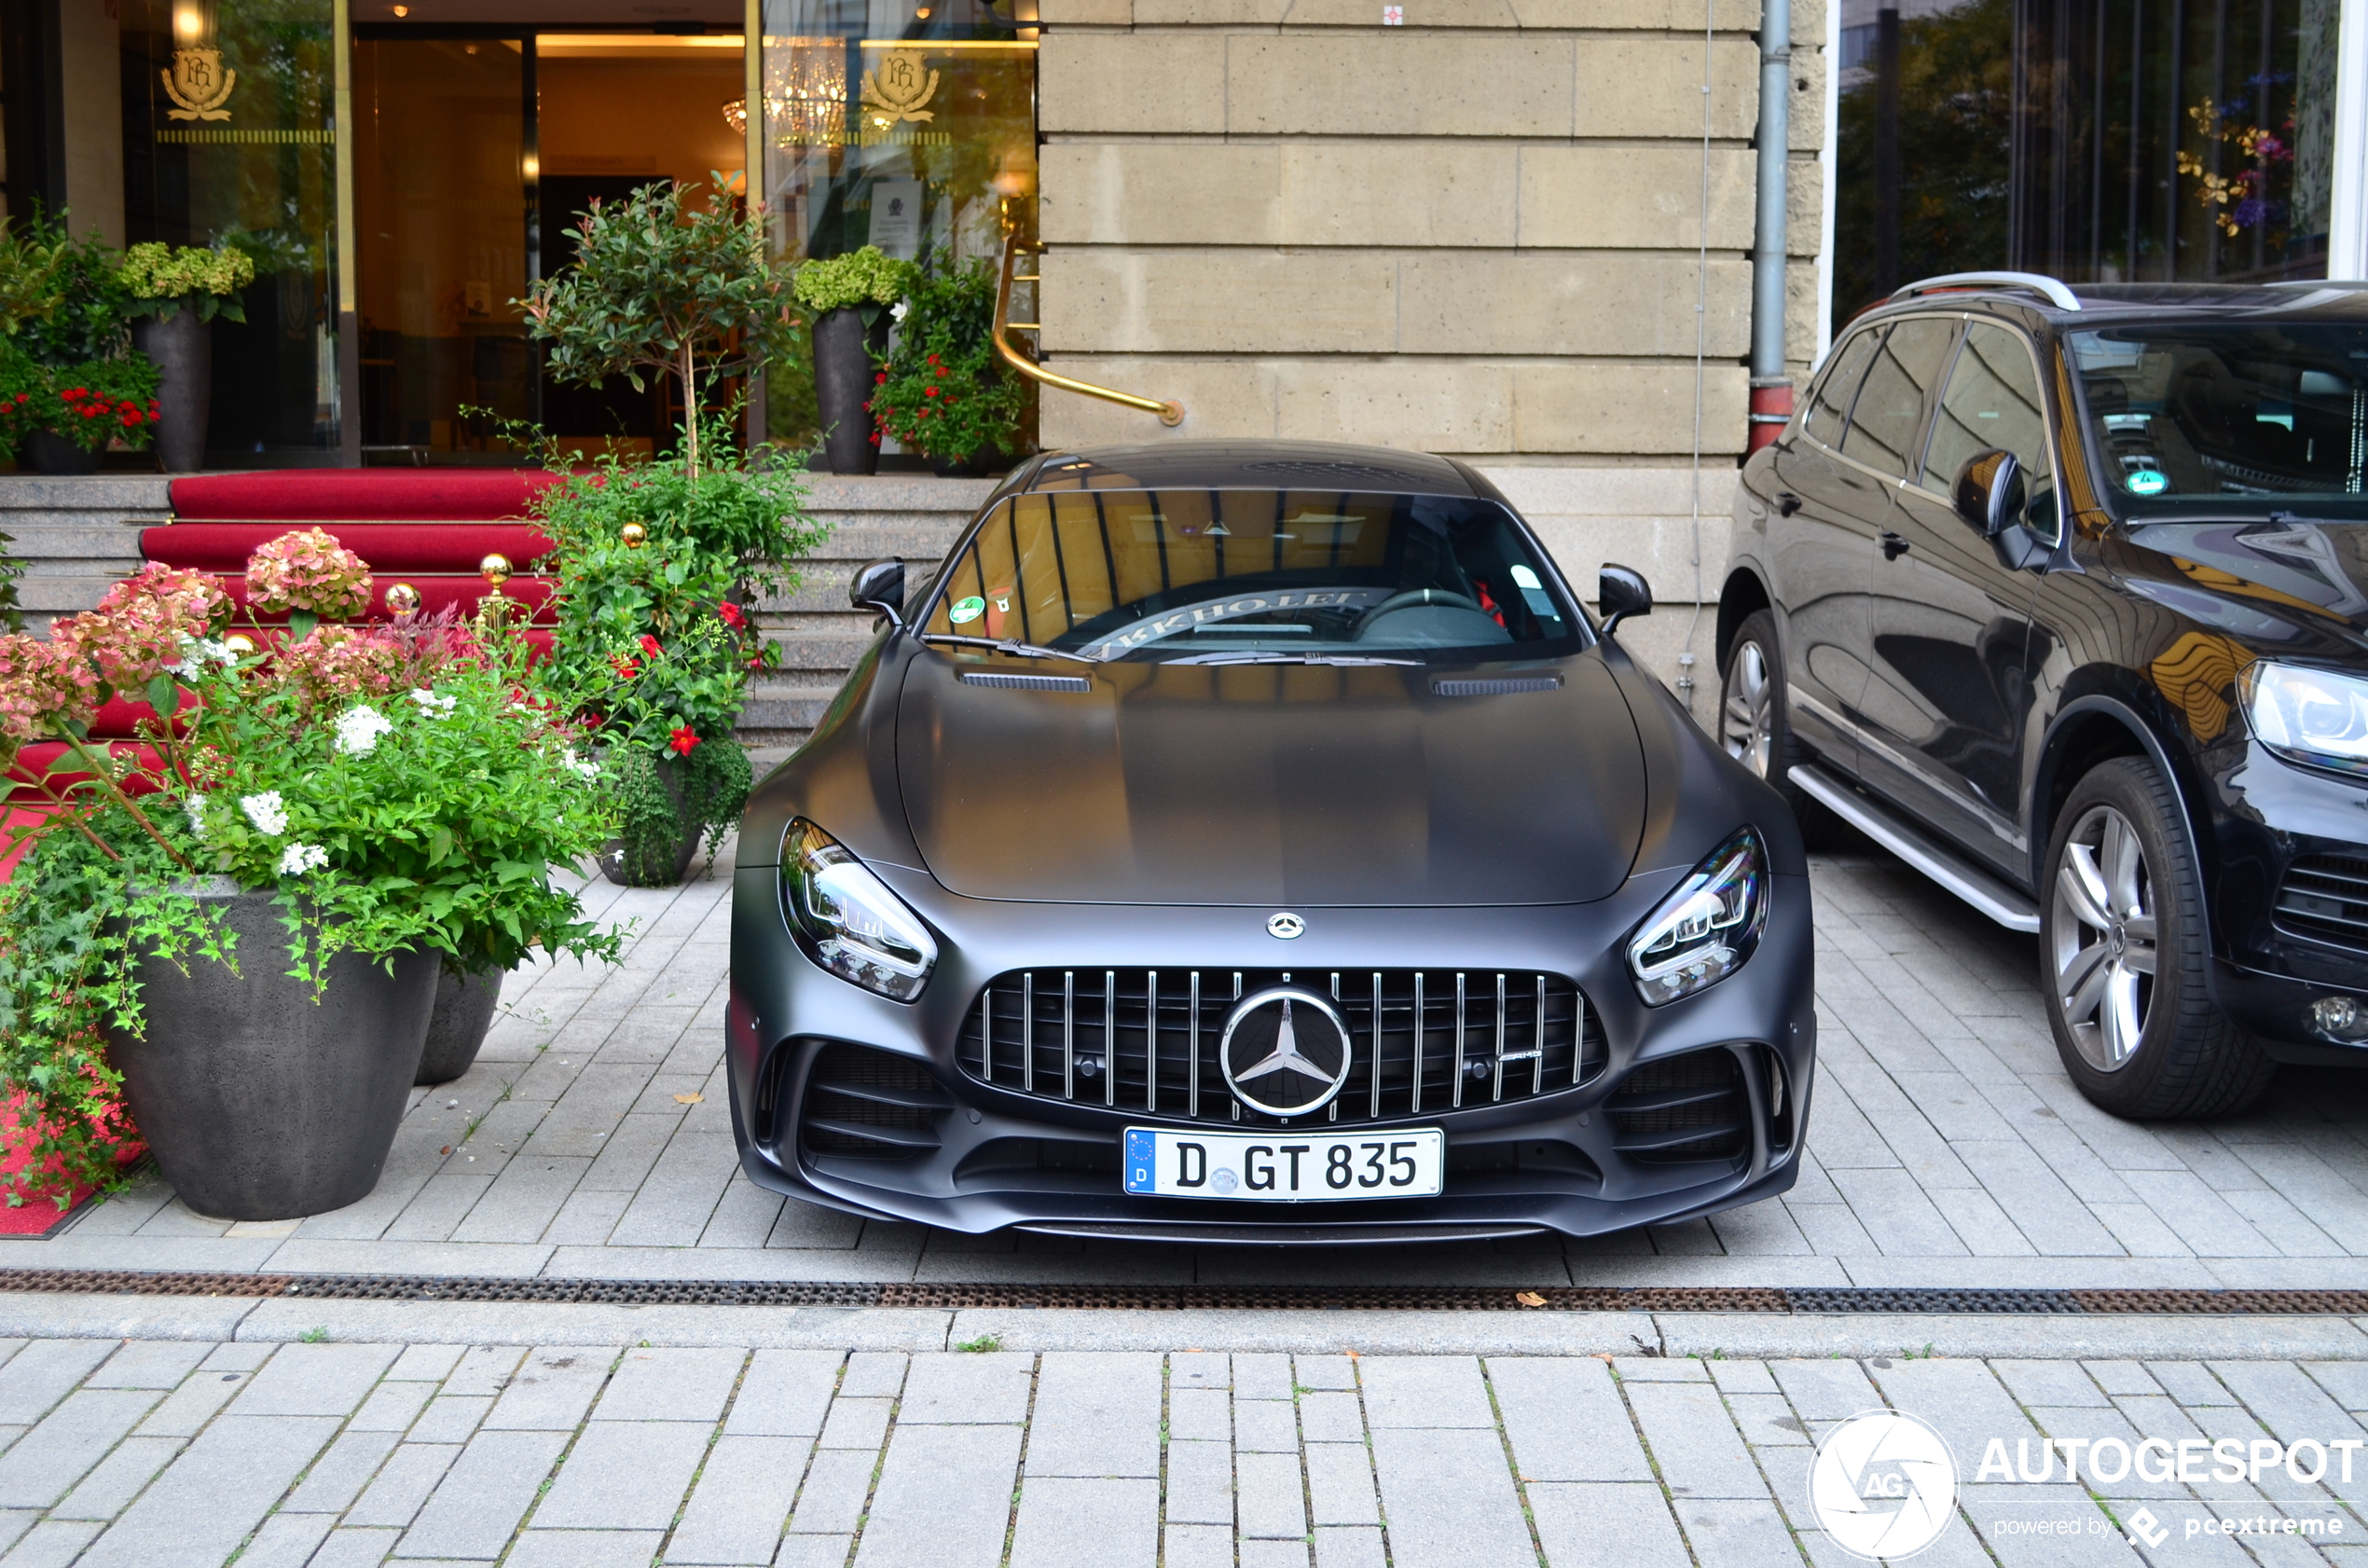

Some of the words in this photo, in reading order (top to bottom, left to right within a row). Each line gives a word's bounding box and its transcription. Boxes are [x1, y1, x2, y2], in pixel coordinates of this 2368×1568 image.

[1136, 1168, 1147, 1182] D
[1176, 1142, 1207, 1188] D
[1245, 1145, 1311, 1191] GT
[1326, 1141, 1418, 1190] 835
